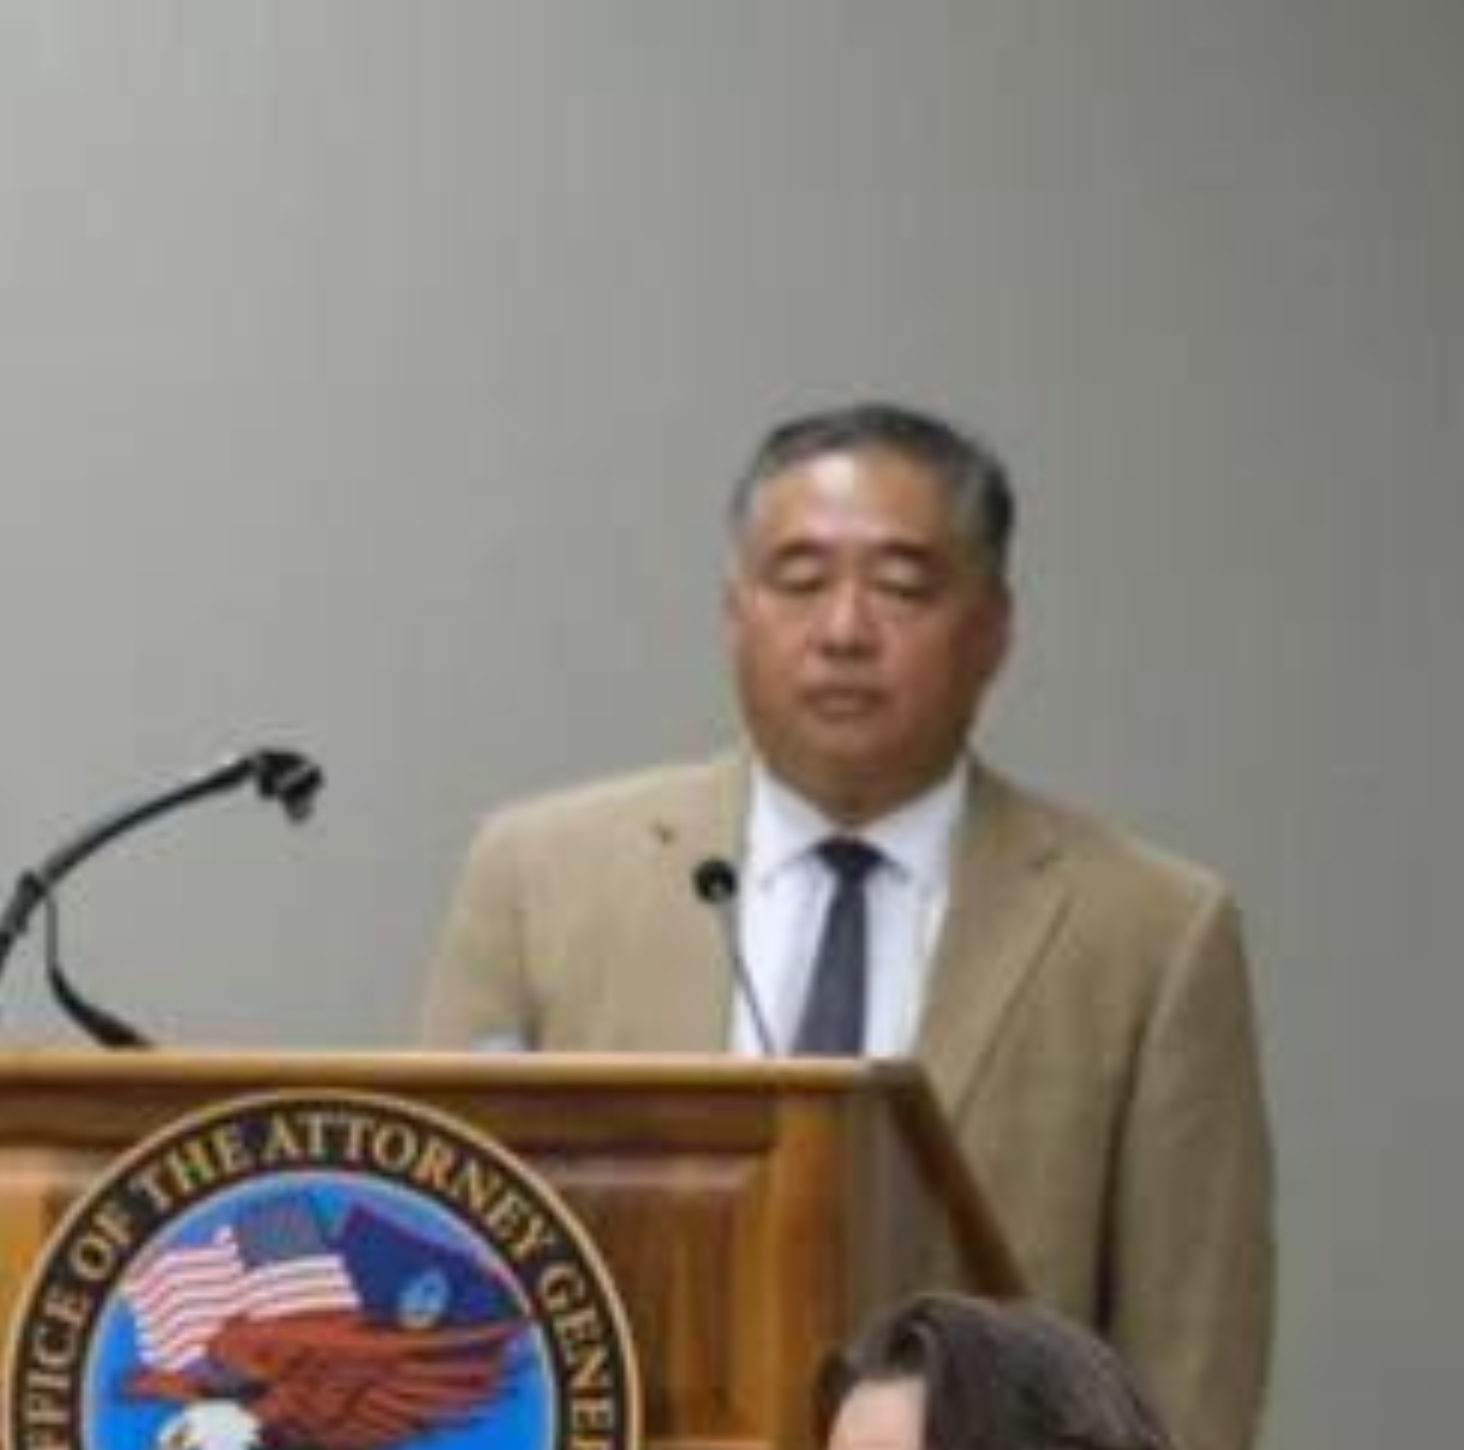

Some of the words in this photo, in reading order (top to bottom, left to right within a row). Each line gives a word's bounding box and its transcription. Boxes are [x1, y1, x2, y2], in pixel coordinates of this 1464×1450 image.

[74, 1203, 131, 1281] OF
[129, 1126, 250, 1211] THE
[263, 1111, 554, 1259] ATTORNEY
